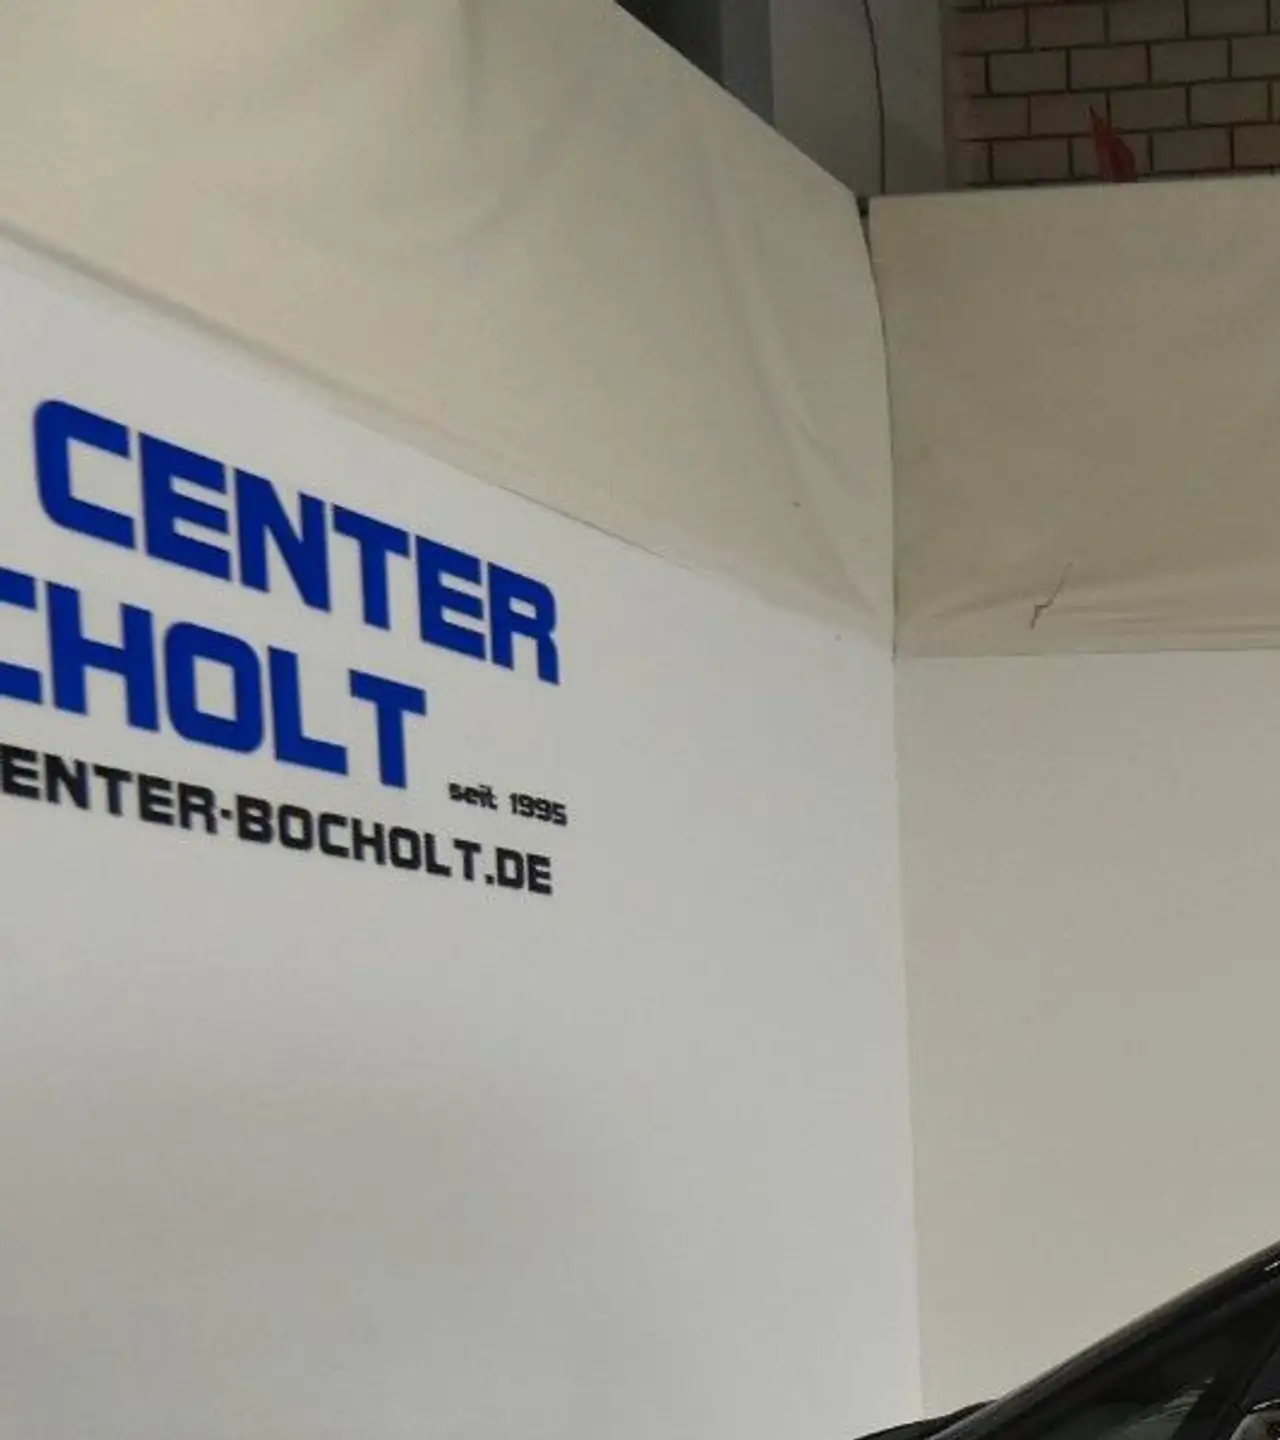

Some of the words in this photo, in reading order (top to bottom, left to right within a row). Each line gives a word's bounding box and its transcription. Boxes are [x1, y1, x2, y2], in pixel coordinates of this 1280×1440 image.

[34, 400, 560, 684] CENTER
[448, 782, 498, 811] seit
[509, 792, 568, 827] 1995
